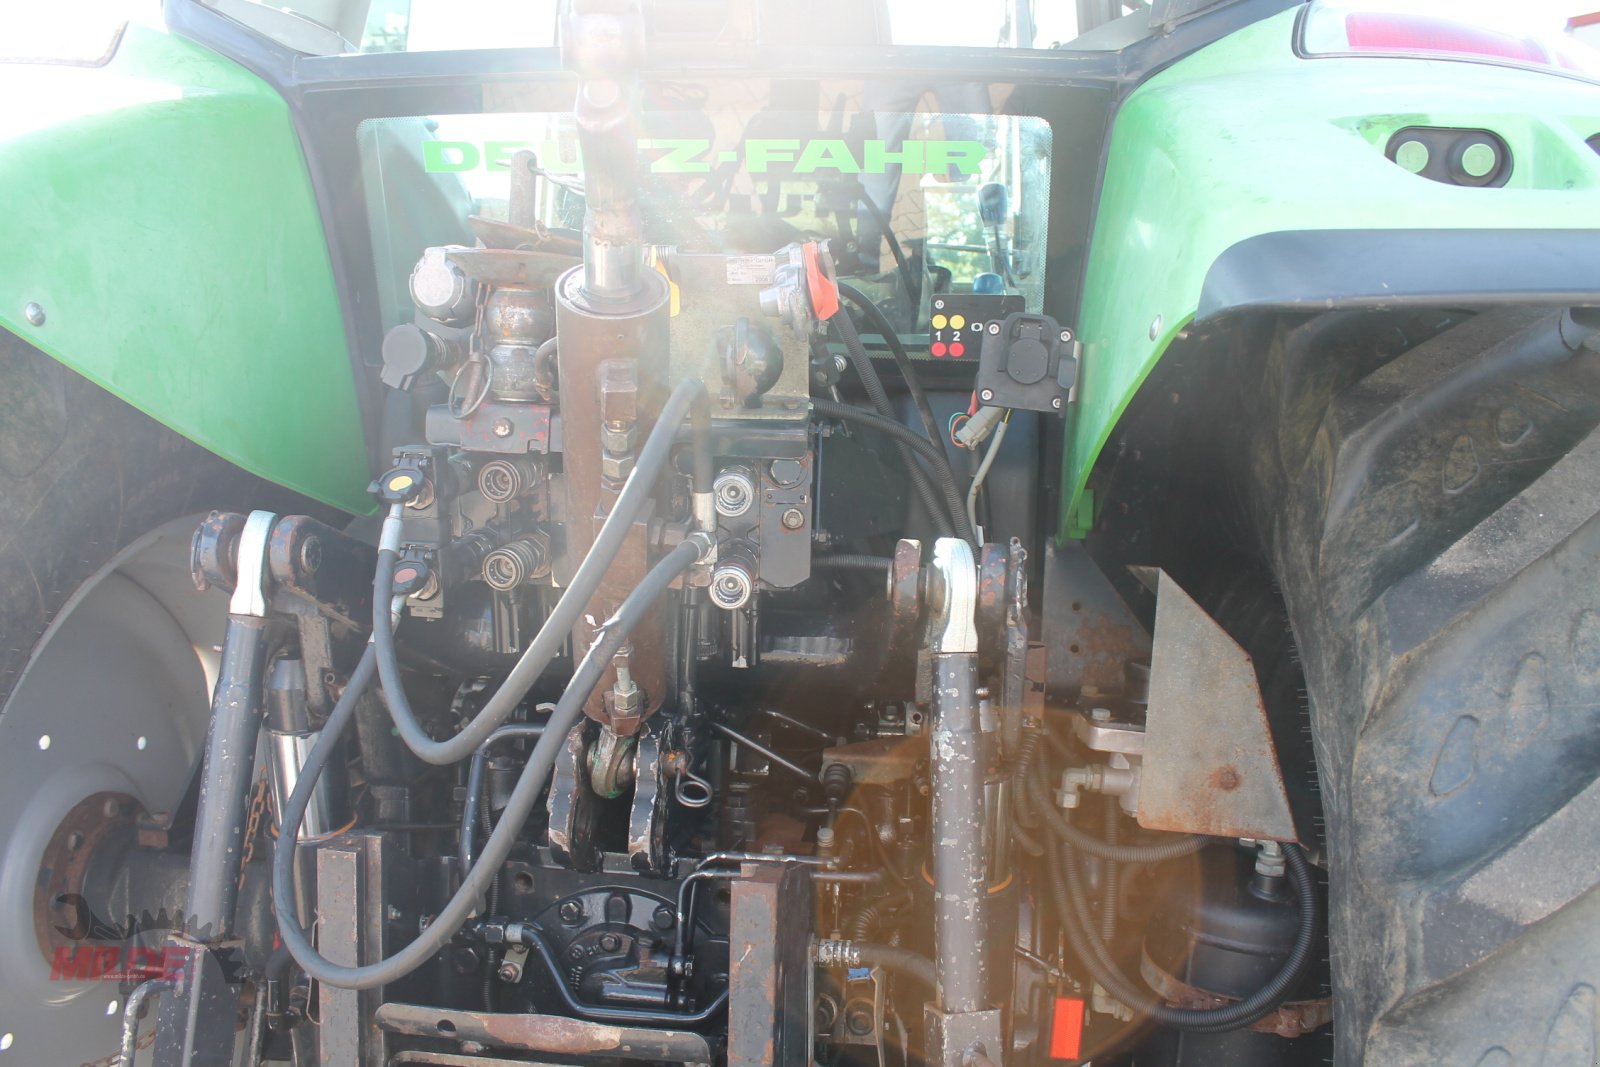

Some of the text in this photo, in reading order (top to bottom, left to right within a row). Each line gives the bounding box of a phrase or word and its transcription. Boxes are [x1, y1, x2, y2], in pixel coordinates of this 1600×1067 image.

[422, 138, 988, 174] DEUZ-FAHR
[935, 331, 961, 341] 1 2
